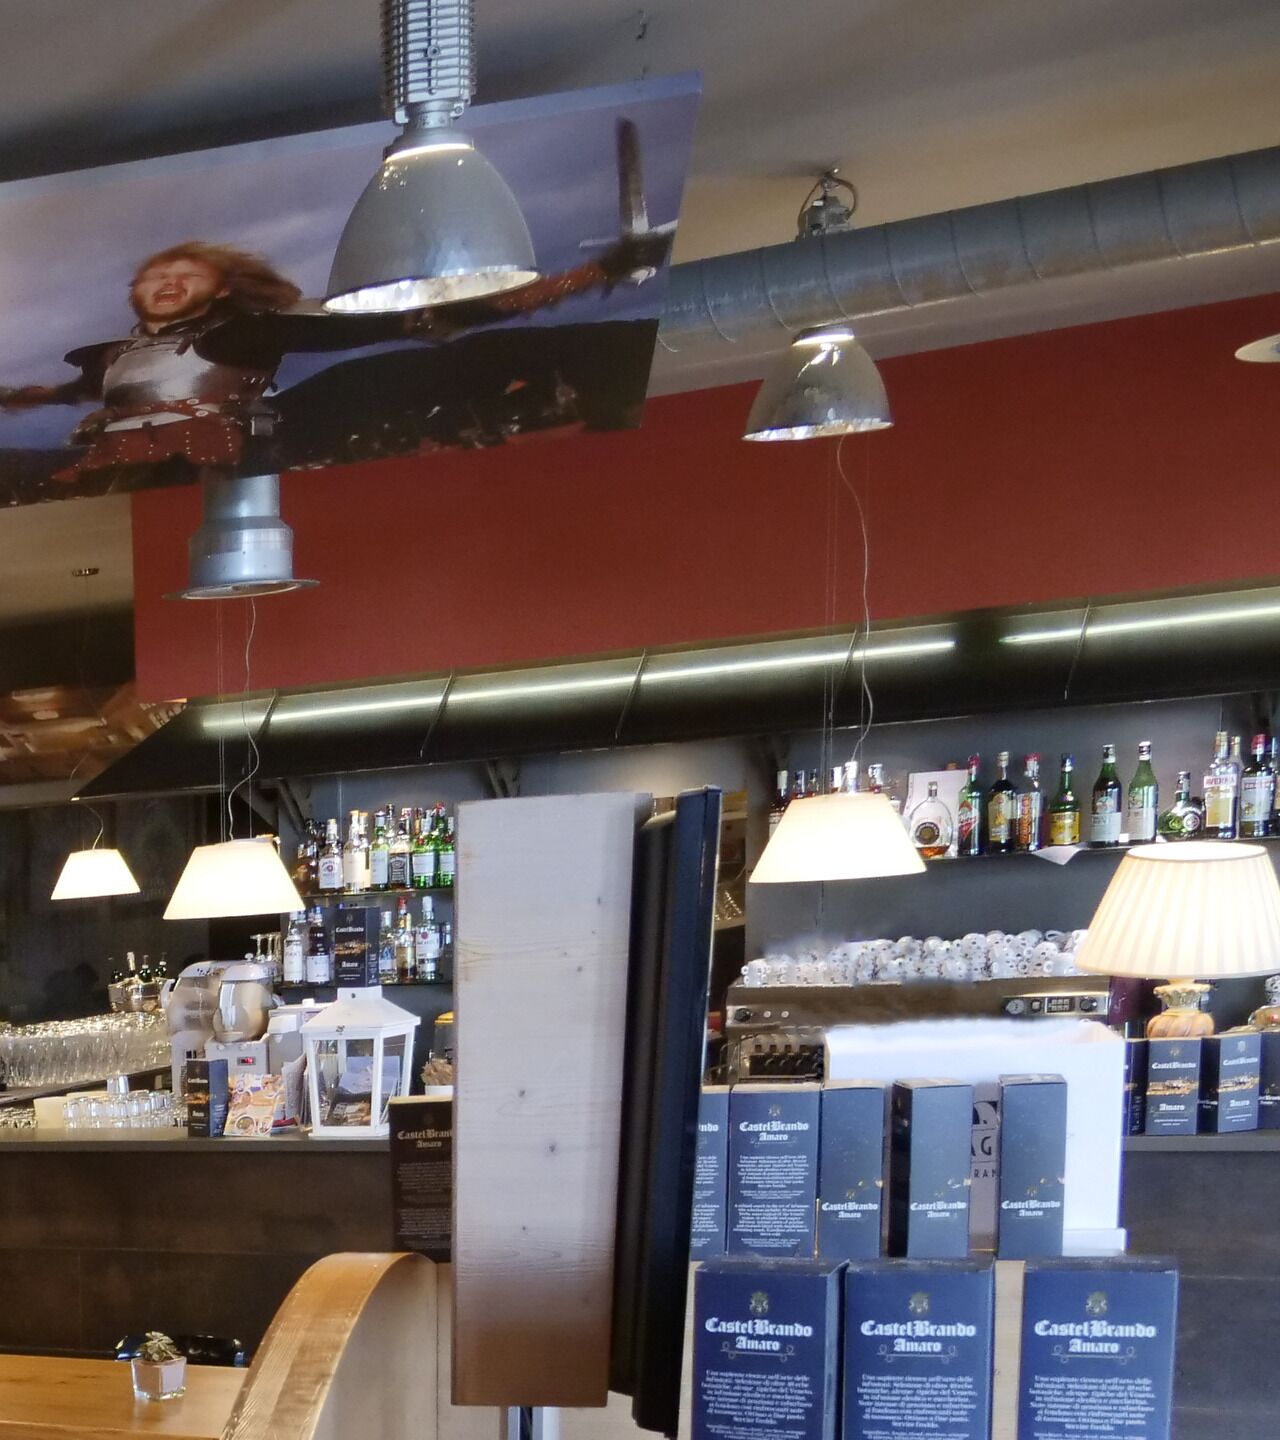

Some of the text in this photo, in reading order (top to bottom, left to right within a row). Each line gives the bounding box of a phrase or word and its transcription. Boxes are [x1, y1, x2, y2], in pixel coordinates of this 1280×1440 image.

[1152, 1062, 1196, 1070] CastelBrando
[739, 1121, 809, 1132] CastelBrando
[397, 1129, 452, 1141] CastelBran
[759, 1132, 788, 1141] Amaro
[416, 1141, 442, 1149] Amaro
[821, 1202, 878, 1211] CastelBrando
[910, 1201, 967, 1211] CastelBrando
[1001, 1200, 1060, 1210] CastelBrando
[1019, 1209, 1043, 1217] Amaro
[705, 1317, 813, 1337] CastelBrando
[860, 1320, 976, 1338] CastelBrando
[1034, 1320, 1157, 1338] CastelBrando
[735, 1336, 780, 1351] Amaro
[893, 1338, 941, 1352] Amaro
[1068, 1338, 1120, 1353] Amaro
